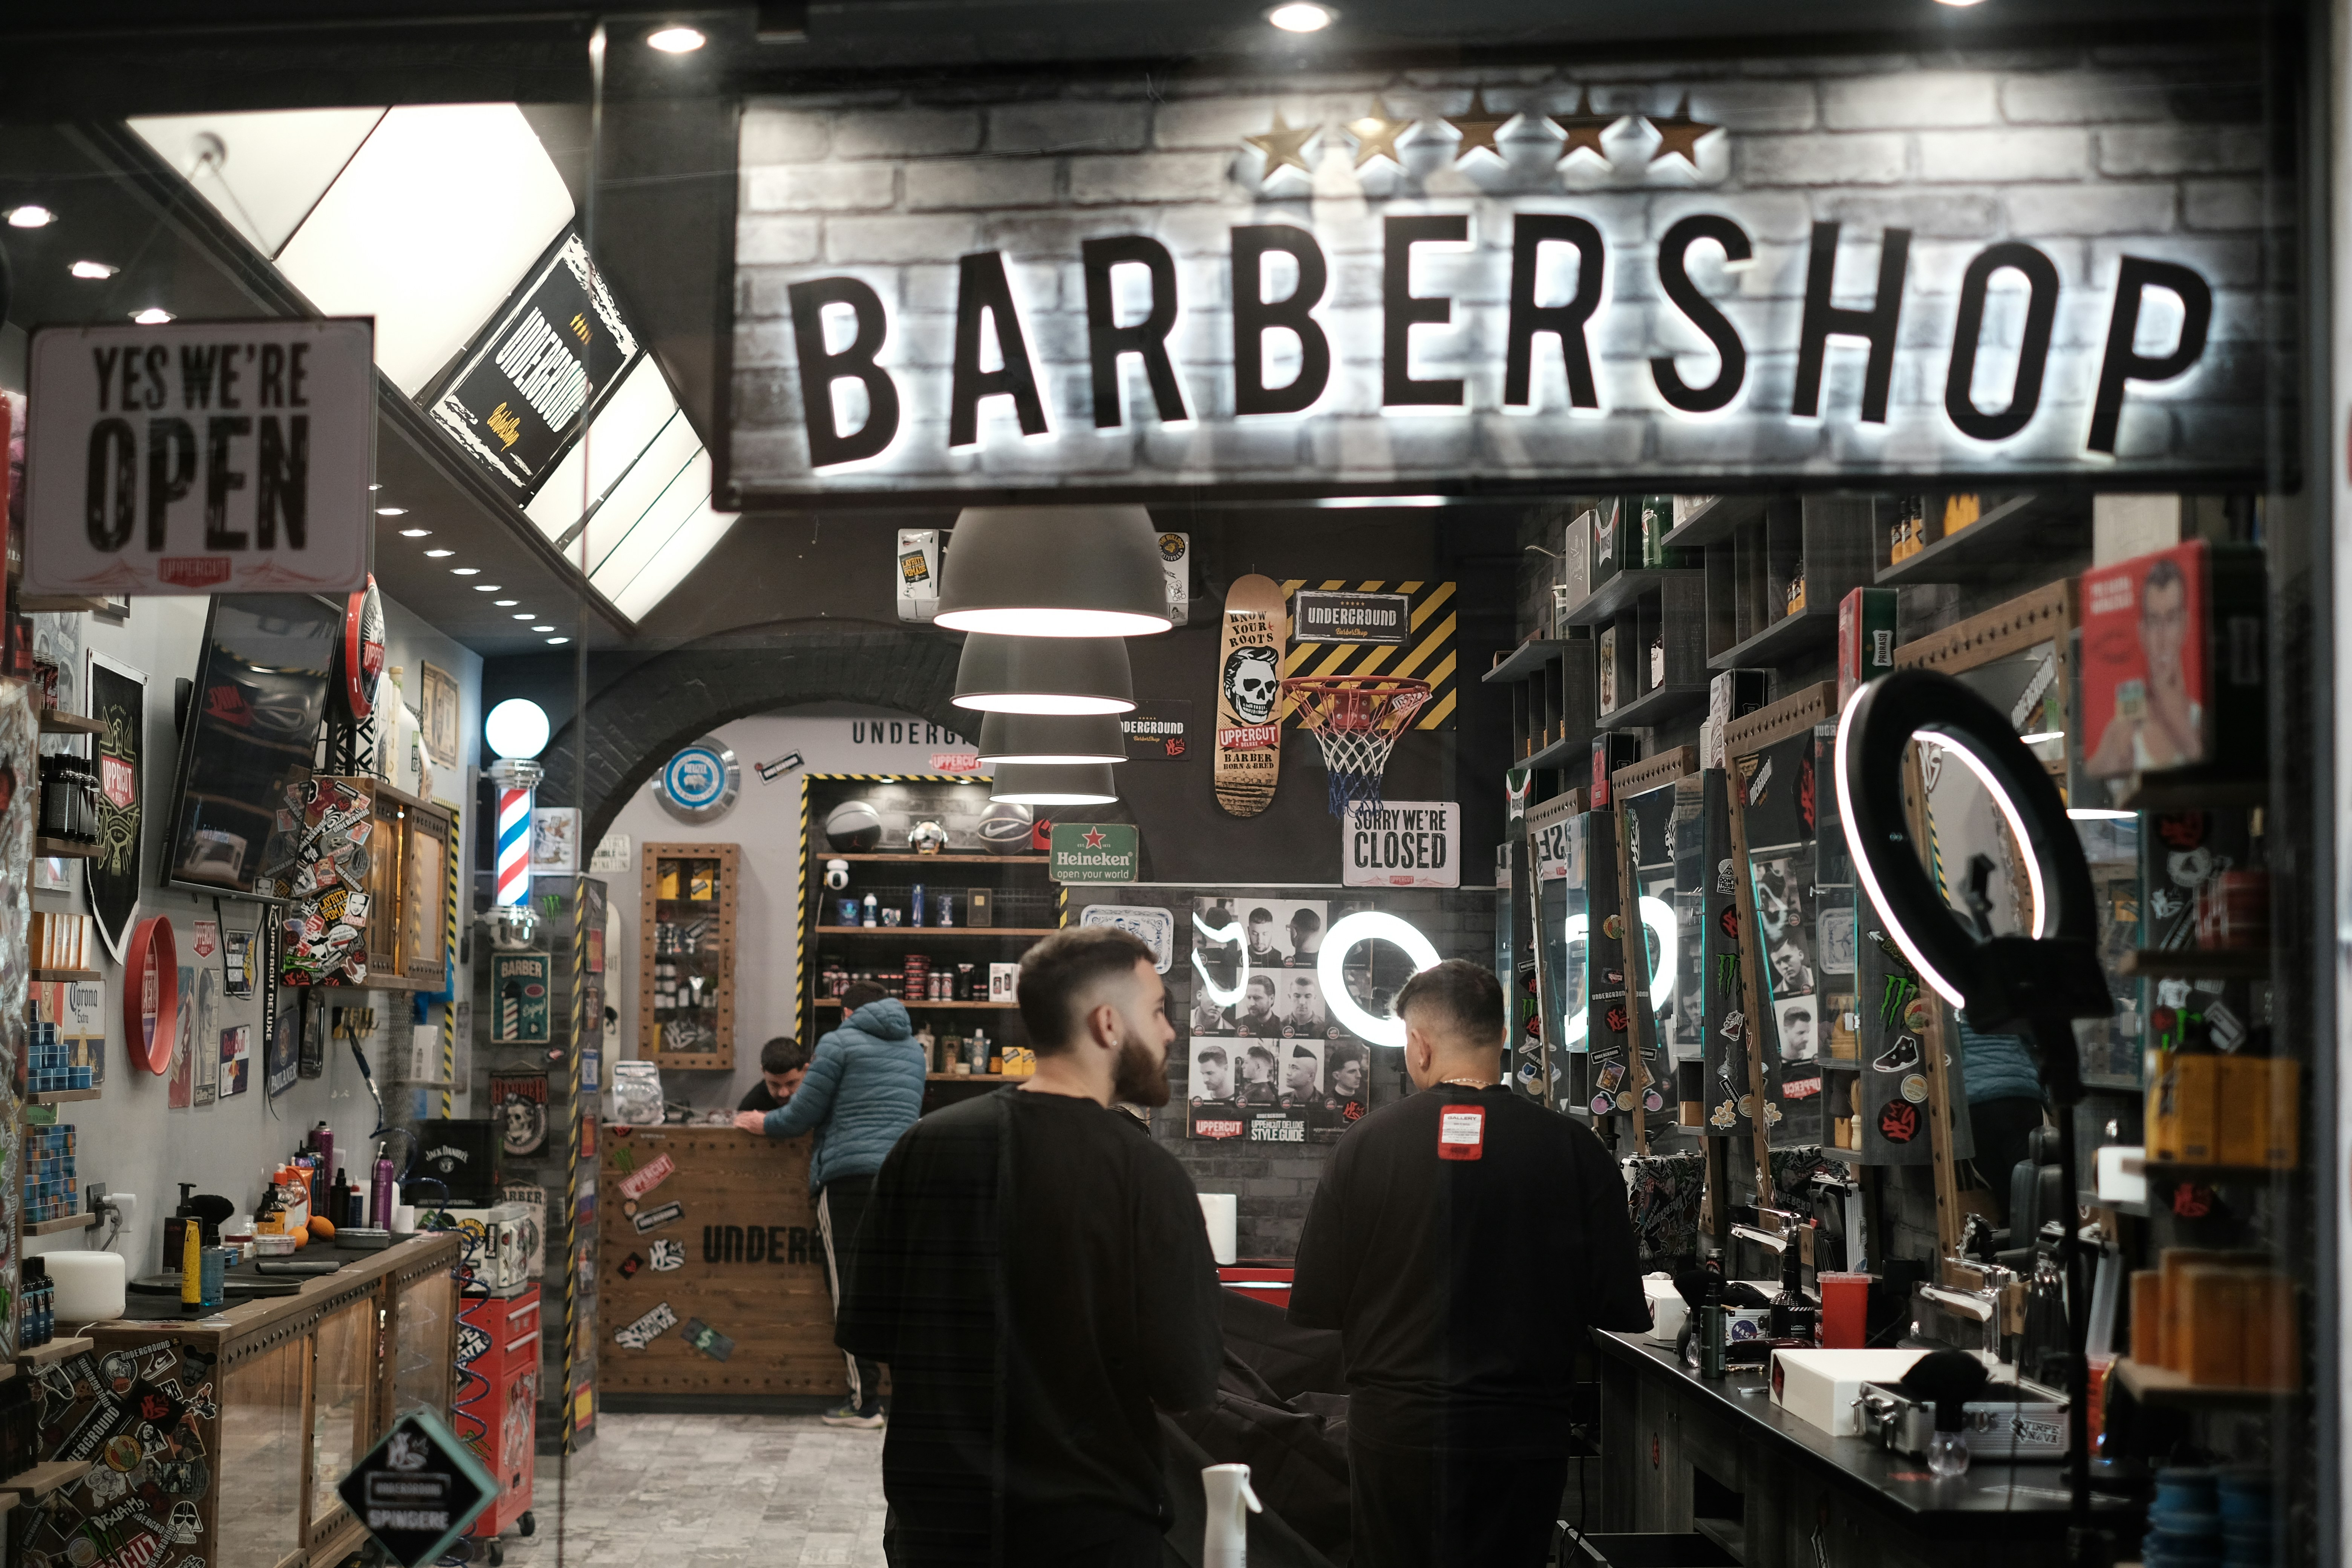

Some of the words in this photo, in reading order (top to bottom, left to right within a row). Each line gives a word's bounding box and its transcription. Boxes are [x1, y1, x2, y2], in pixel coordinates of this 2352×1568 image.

[787, 212, 2214, 470] BARBERSHOP
[93, 343, 169, 412] YES
[180, 342, 311, 410] WE'RE
[86, 415, 309, 553] OPEN
[1165, 534, 1184, 548] BULLDOG
[902, 556, 924, 568] LAYRITE
[904, 565, 926, 577] POMADE
[1230, 611, 1268, 623] KNOW
[1308, 607, 1396, 626] UNDERGROUND
[1232, 622, 1267, 635] YOUR
[1230, 633, 1274, 648] ROOTS
[1878, 633, 1888, 663] PRORASO
[853, 721, 966, 744] UNDERG
[1121, 720, 1184, 734] NDERGROUND
[1220, 726, 1276, 746] UPPERCUT
[1224, 753, 1272, 763] BARBER
[332, 808, 370, 834] UNDERGROUND
[1354, 809, 1400, 830] SORRY
[1403, 809, 1447, 831] WE'RE
[1057, 852, 1130, 866] Heineken
[1354, 831, 1447, 869] CLOSED
[1057, 870, 1080, 879] open
[1082, 871, 1102, 879] your
[1104, 870, 1129, 879] world
[318, 890, 348, 911] LAYRITE
[324, 902, 347, 922] POMA
[266, 927, 275, 990] UPPERCUT
[501, 960, 542, 979] BARBER
[70, 981, 98, 1015] Corona
[1592, 991, 1626, 1000] UNDERGROUN
[77, 1009, 89, 1024] Extra
[265, 992, 274, 1042] DELUXE
[271, 1061, 297, 1094] PAULANER
[1197, 1121, 1242, 1134] UPPERCUT
[1251, 1121, 1281, 1129] UPPERCUT
[1282, 1121, 1305, 1129] DELUXE
[1251, 1129, 1280, 1141] STYLE
[1279, 1129, 1305, 1142] GUIDE
[426, 1147, 443, 1161] JACK
[442, 1144, 469, 1164] DANIEL'S
[502, 1190, 543, 1204] ARBER
[1734, 1325, 1754, 1340] NASA
[121, 1340, 170, 1361] UNDERGROUND
[78, 1357, 111, 1408] UNDERGROUND
[367, 1509, 449, 1531] SPINGERE
